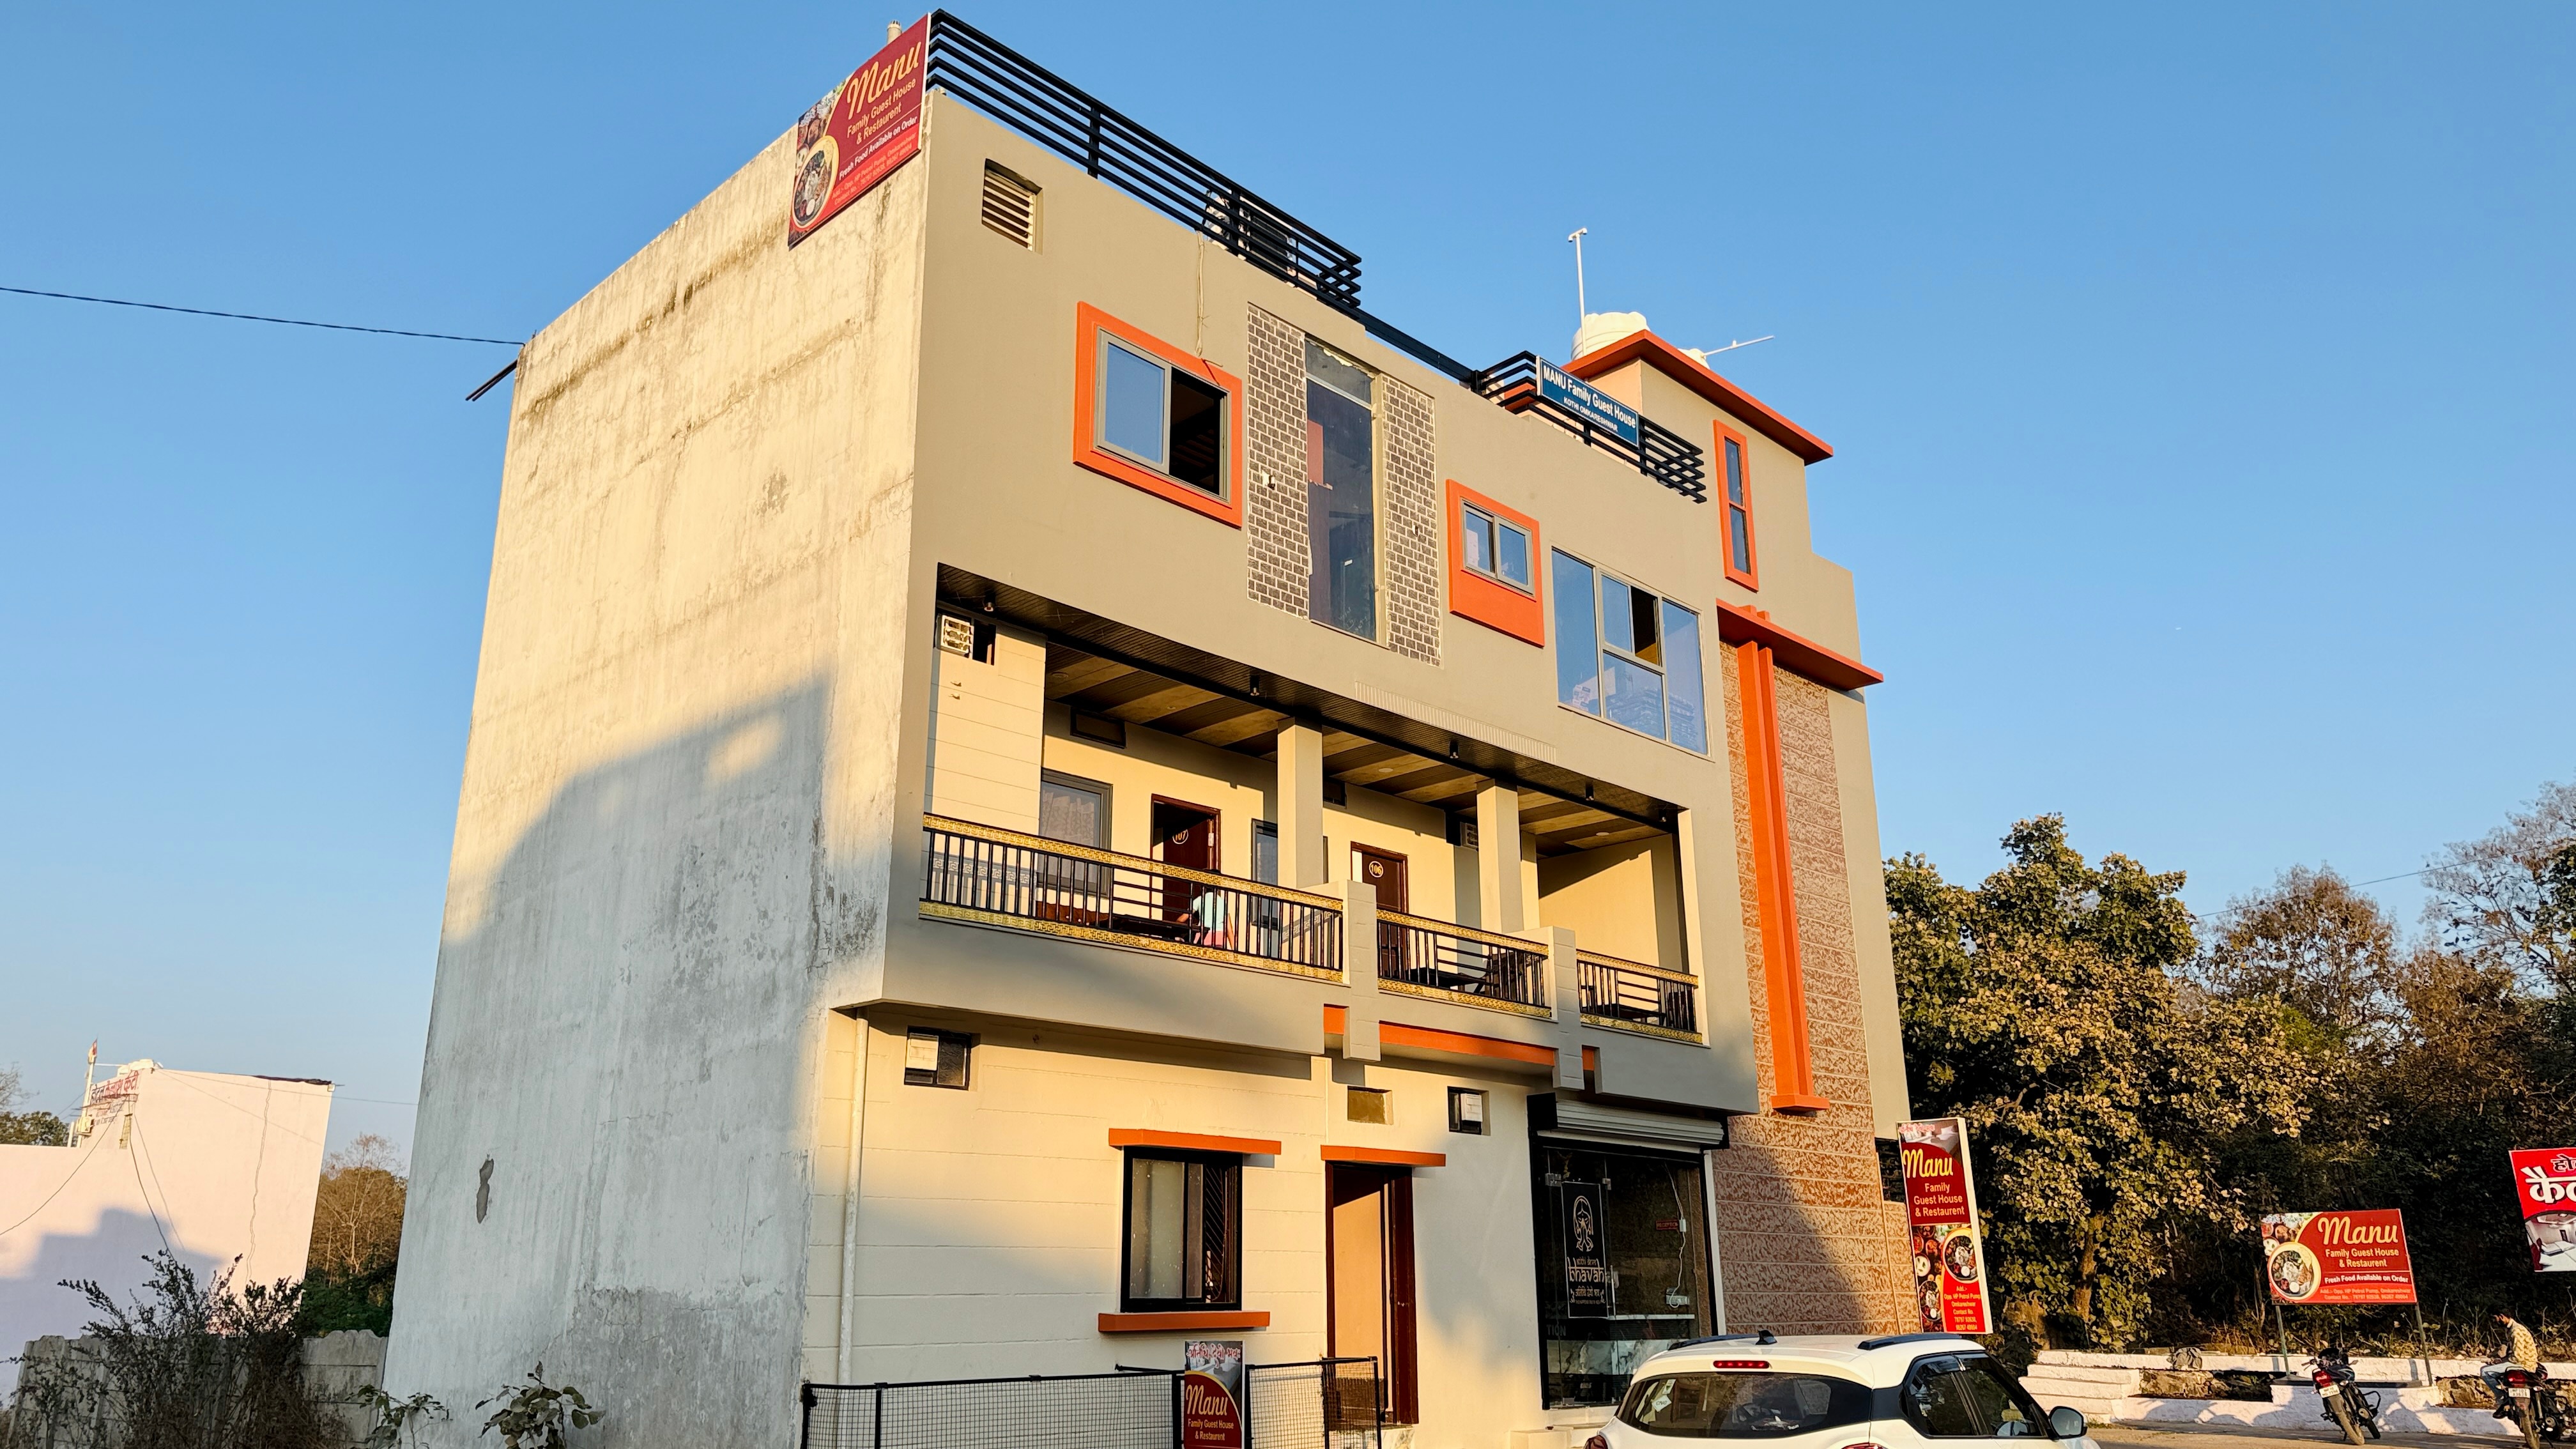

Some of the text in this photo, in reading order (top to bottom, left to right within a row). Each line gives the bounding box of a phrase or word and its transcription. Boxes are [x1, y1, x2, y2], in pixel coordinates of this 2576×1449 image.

[847, 42, 921, 119] Manu
[847, 79, 916, 138] Family Guest House
[856, 132, 862, 144] &
[864, 102, 901, 139] Restaurent
[839, 162, 854, 180] Fresh
[855, 148, 869, 166] Food
[869, 132, 893, 155] Available
[893, 126, 900, 136] on
[901, 116, 917, 130] Order
[1544, 365, 1636, 429] MANU Family Guest House
[1563, 396, 1618, 432] KOTHI OMKARESHWAR
[1370, 864, 1382, 875] 106
[1903, 1149, 1953, 1178] Manu
[2550, 1153, 2576, 1172] हो
[1914, 1194, 1963, 1205] Guest House
[1925, 1183, 1950, 1193] Family
[1915, 1206, 1965, 1216] & Restaurent
[2318, 1216, 2398, 1245] Manu
[2326, 1248, 2399, 1259] Family Guest House
[2339, 1259, 2388, 1268] & Restaurent
[1186, 1384, 1228, 1416] Manu
[1188, 1418, 1234, 1429] Family Guest House
[1195, 1430, 1225, 1441] & Restaurent
